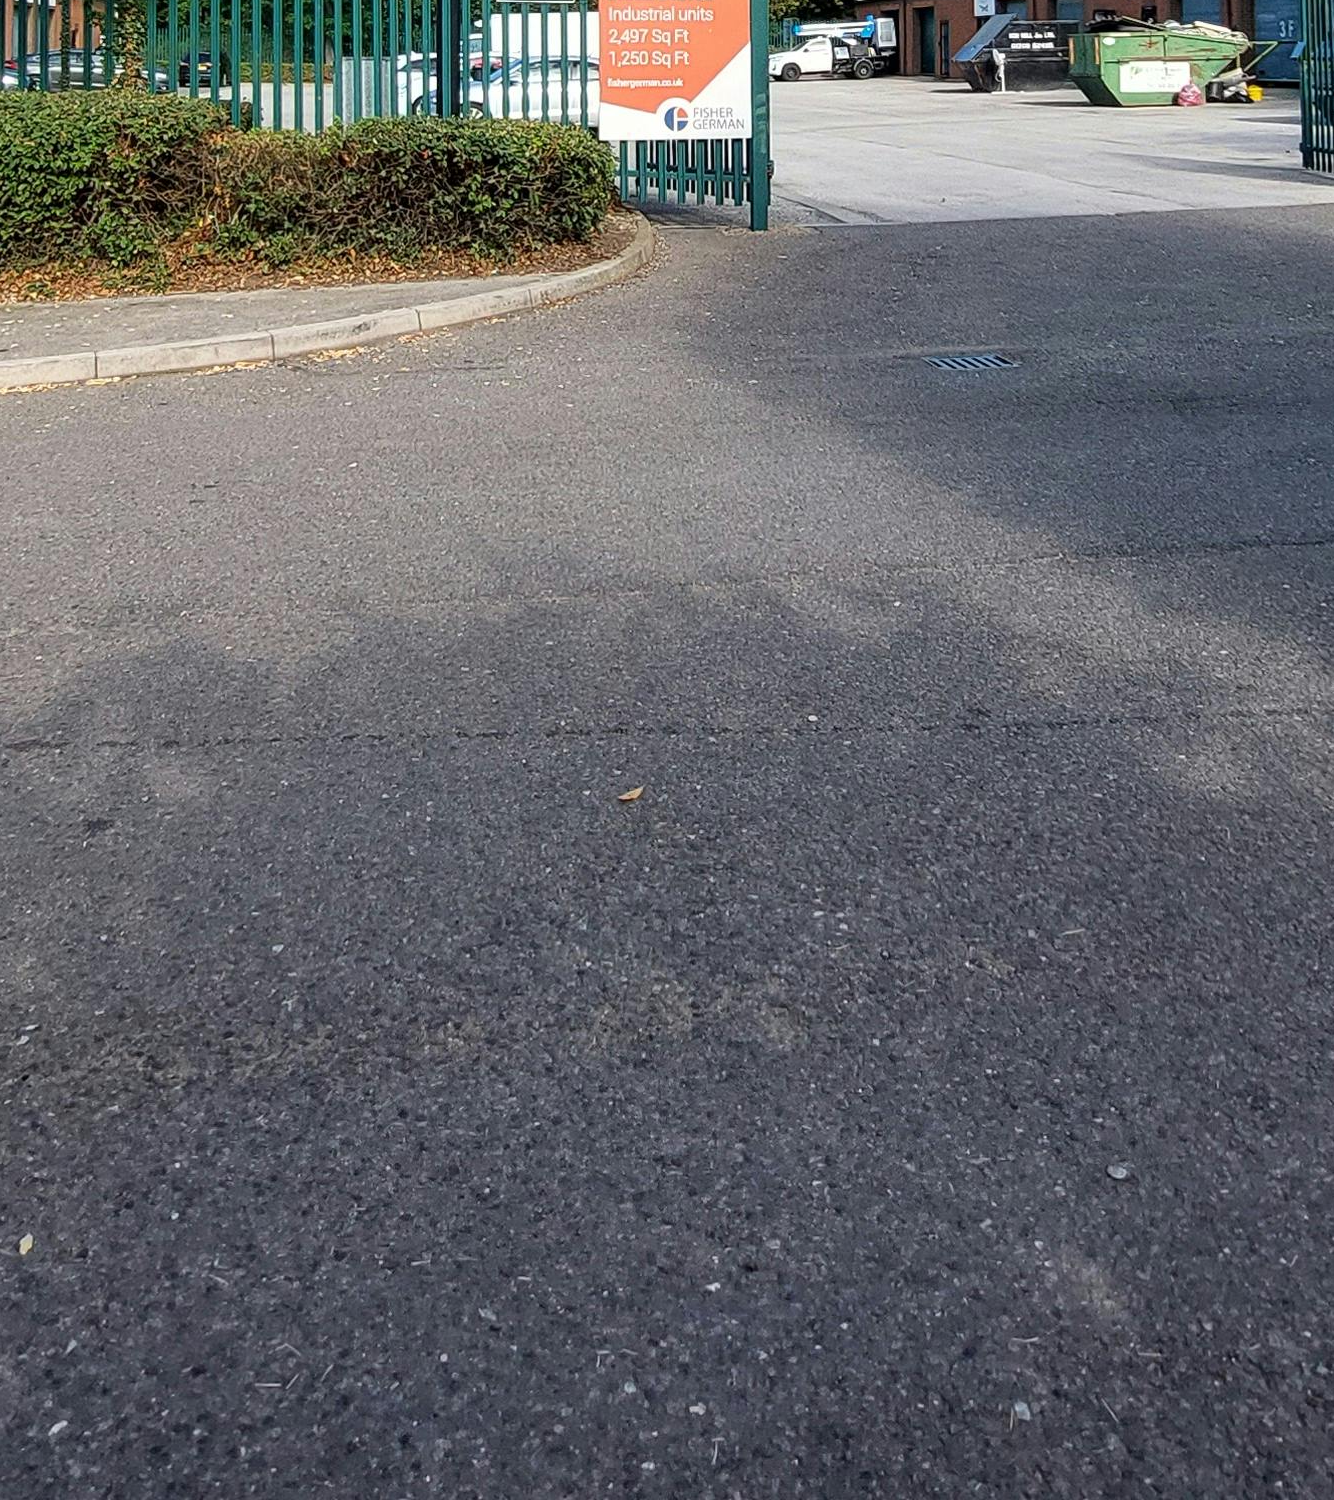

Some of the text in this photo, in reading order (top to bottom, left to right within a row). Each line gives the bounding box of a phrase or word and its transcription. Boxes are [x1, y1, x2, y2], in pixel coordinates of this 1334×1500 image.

[608, 6, 714, 21] Industrial units
[608, 29, 690, 46] 2,497 Sq Ft
[609, 51, 690, 68] 1,250 Sq Ft
[607, 77, 683, 88] fishergerman.co.uk
[693, 107, 733, 118] FISHER
[693, 119, 745, 130] GERMAN
